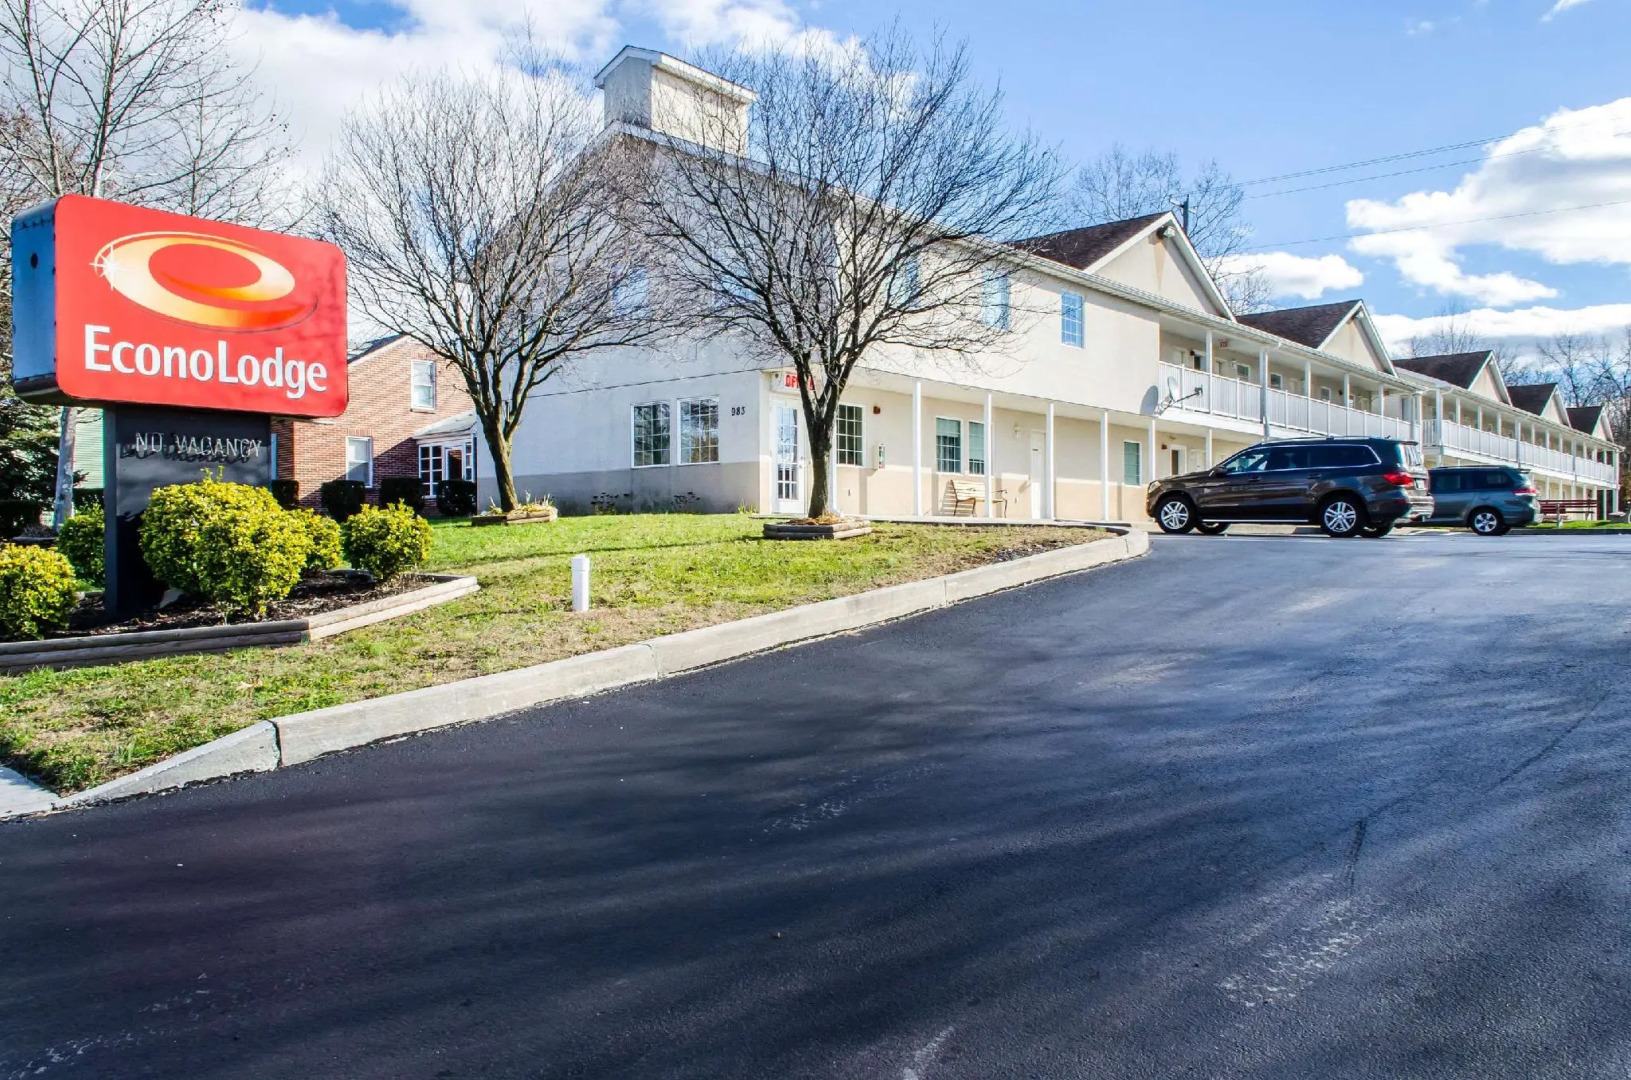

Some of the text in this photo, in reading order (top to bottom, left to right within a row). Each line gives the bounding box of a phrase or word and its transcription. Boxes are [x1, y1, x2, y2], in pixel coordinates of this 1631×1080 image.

[84, 323, 328, 399] EconoLodge
[731, 406, 746, 417] 983
[135, 431, 262, 459] NO VACANCY
